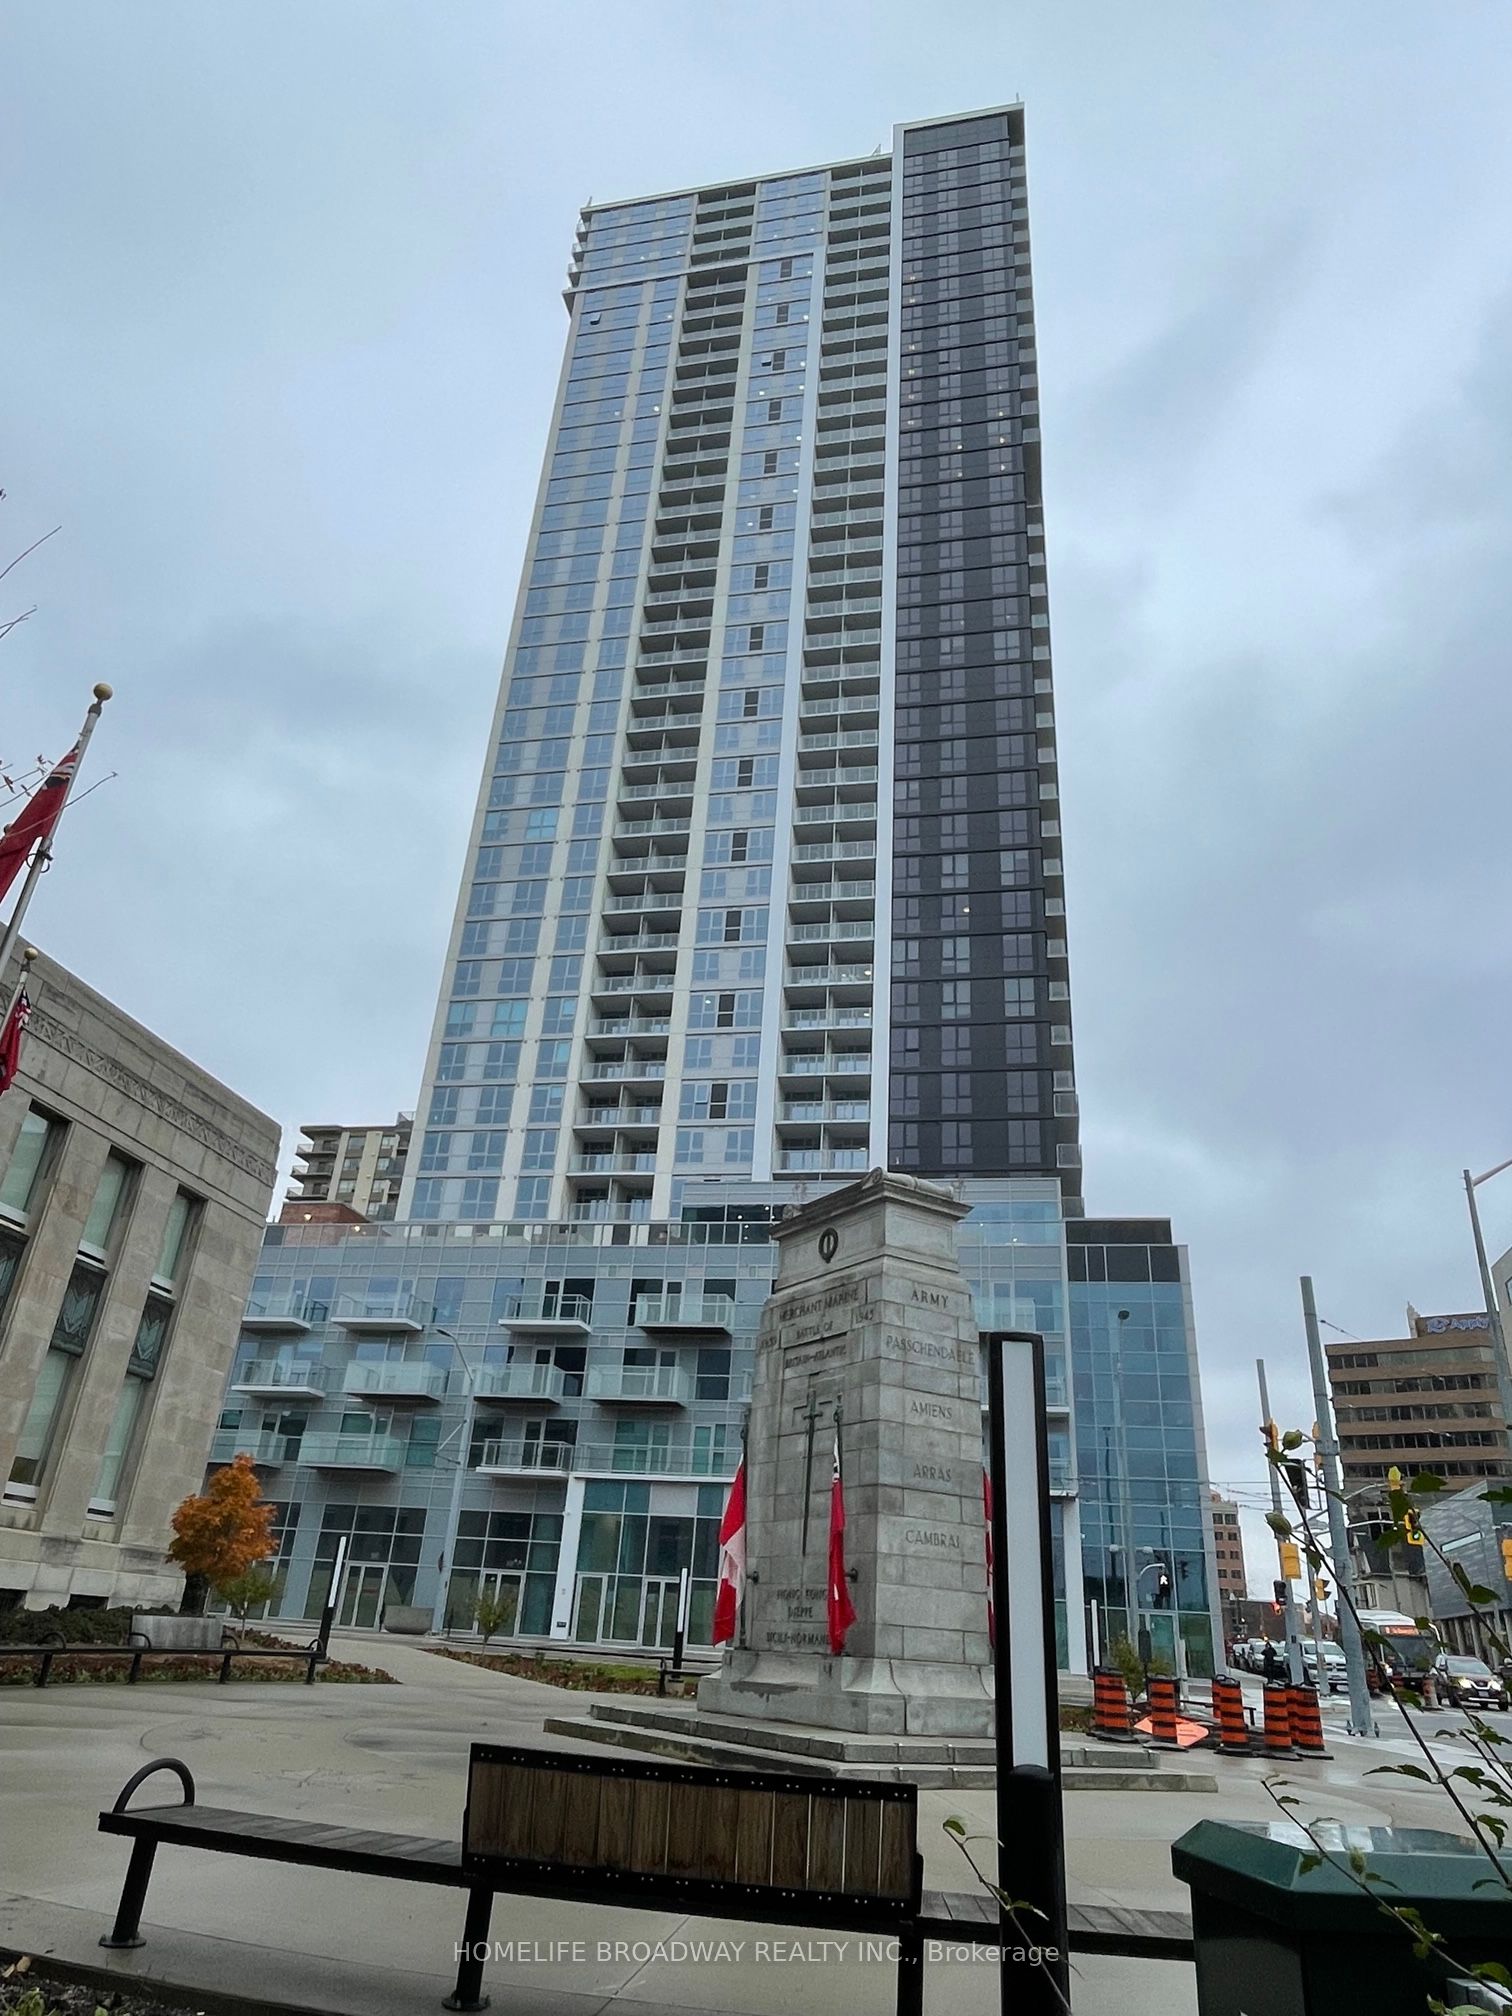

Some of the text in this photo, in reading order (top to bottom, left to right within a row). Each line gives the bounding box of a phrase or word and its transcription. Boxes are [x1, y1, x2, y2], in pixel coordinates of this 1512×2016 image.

[911, 1289, 949, 1308] ARMY
[885, 1334, 975, 1365] PASSCHENDAELE
[911, 1401, 953, 1420] AMIENS
[913, 1463, 952, 1483] ARRAS
[905, 1529, 961, 1549] CAMBRAI
